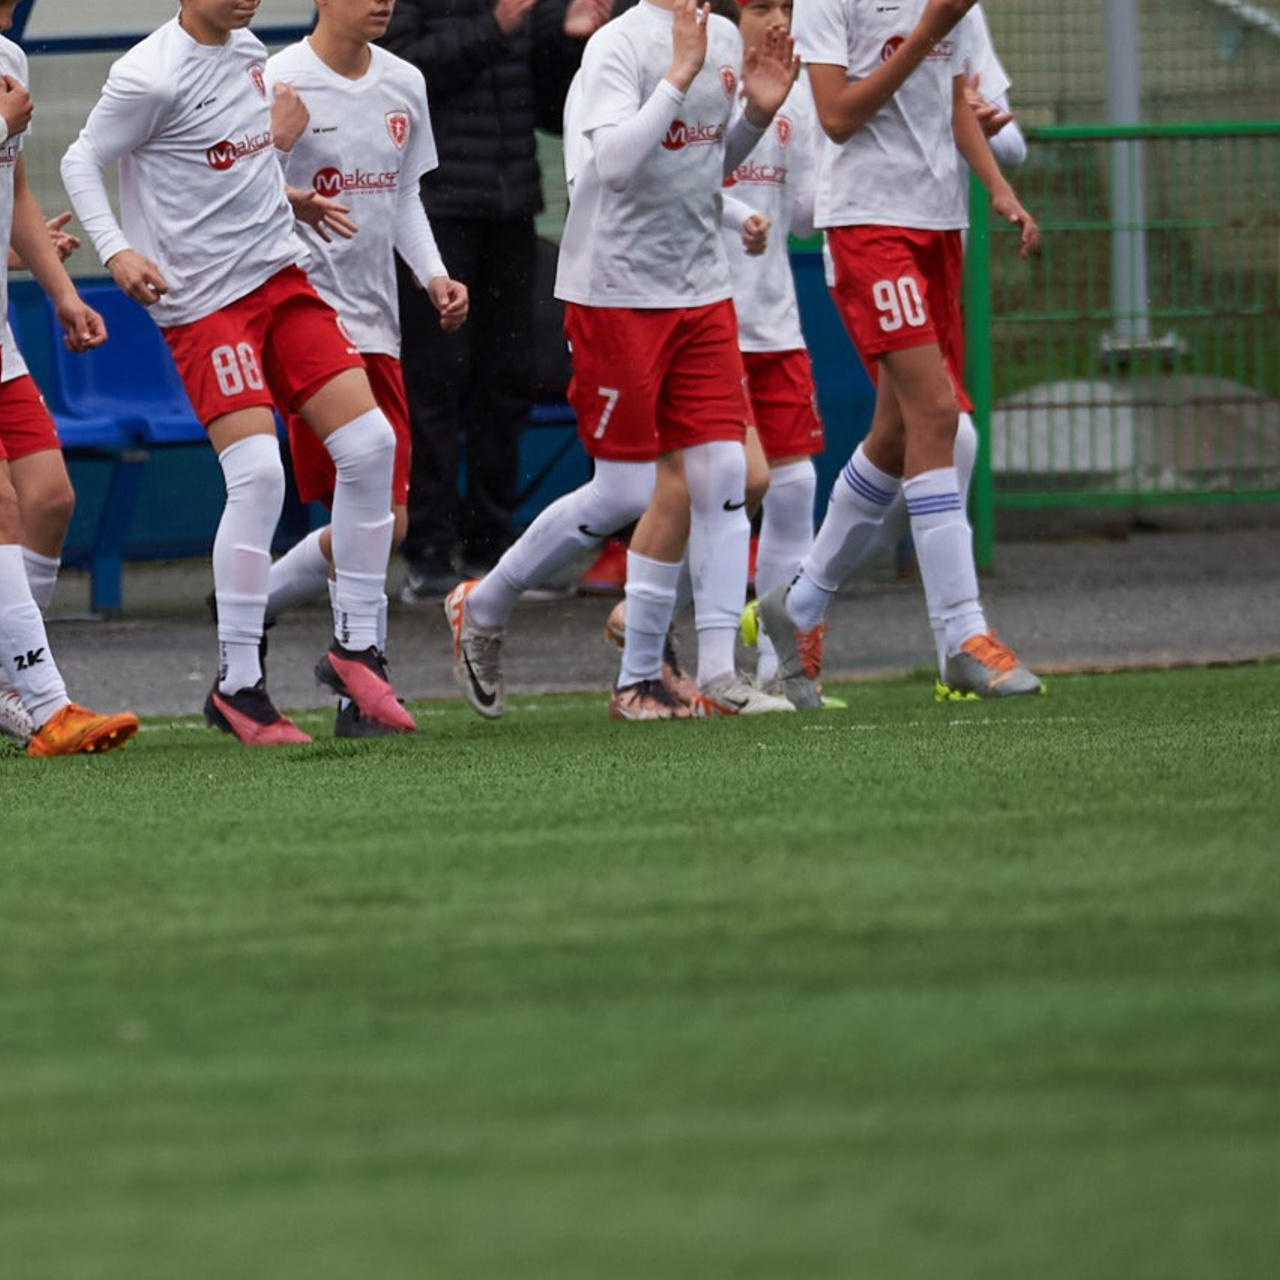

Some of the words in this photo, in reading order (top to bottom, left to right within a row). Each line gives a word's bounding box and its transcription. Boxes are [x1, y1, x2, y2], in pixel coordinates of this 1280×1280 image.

[872, 275, 926, 332] 90
[211, 341, 264, 396] 88
[593, 386, 619, 439] 7
